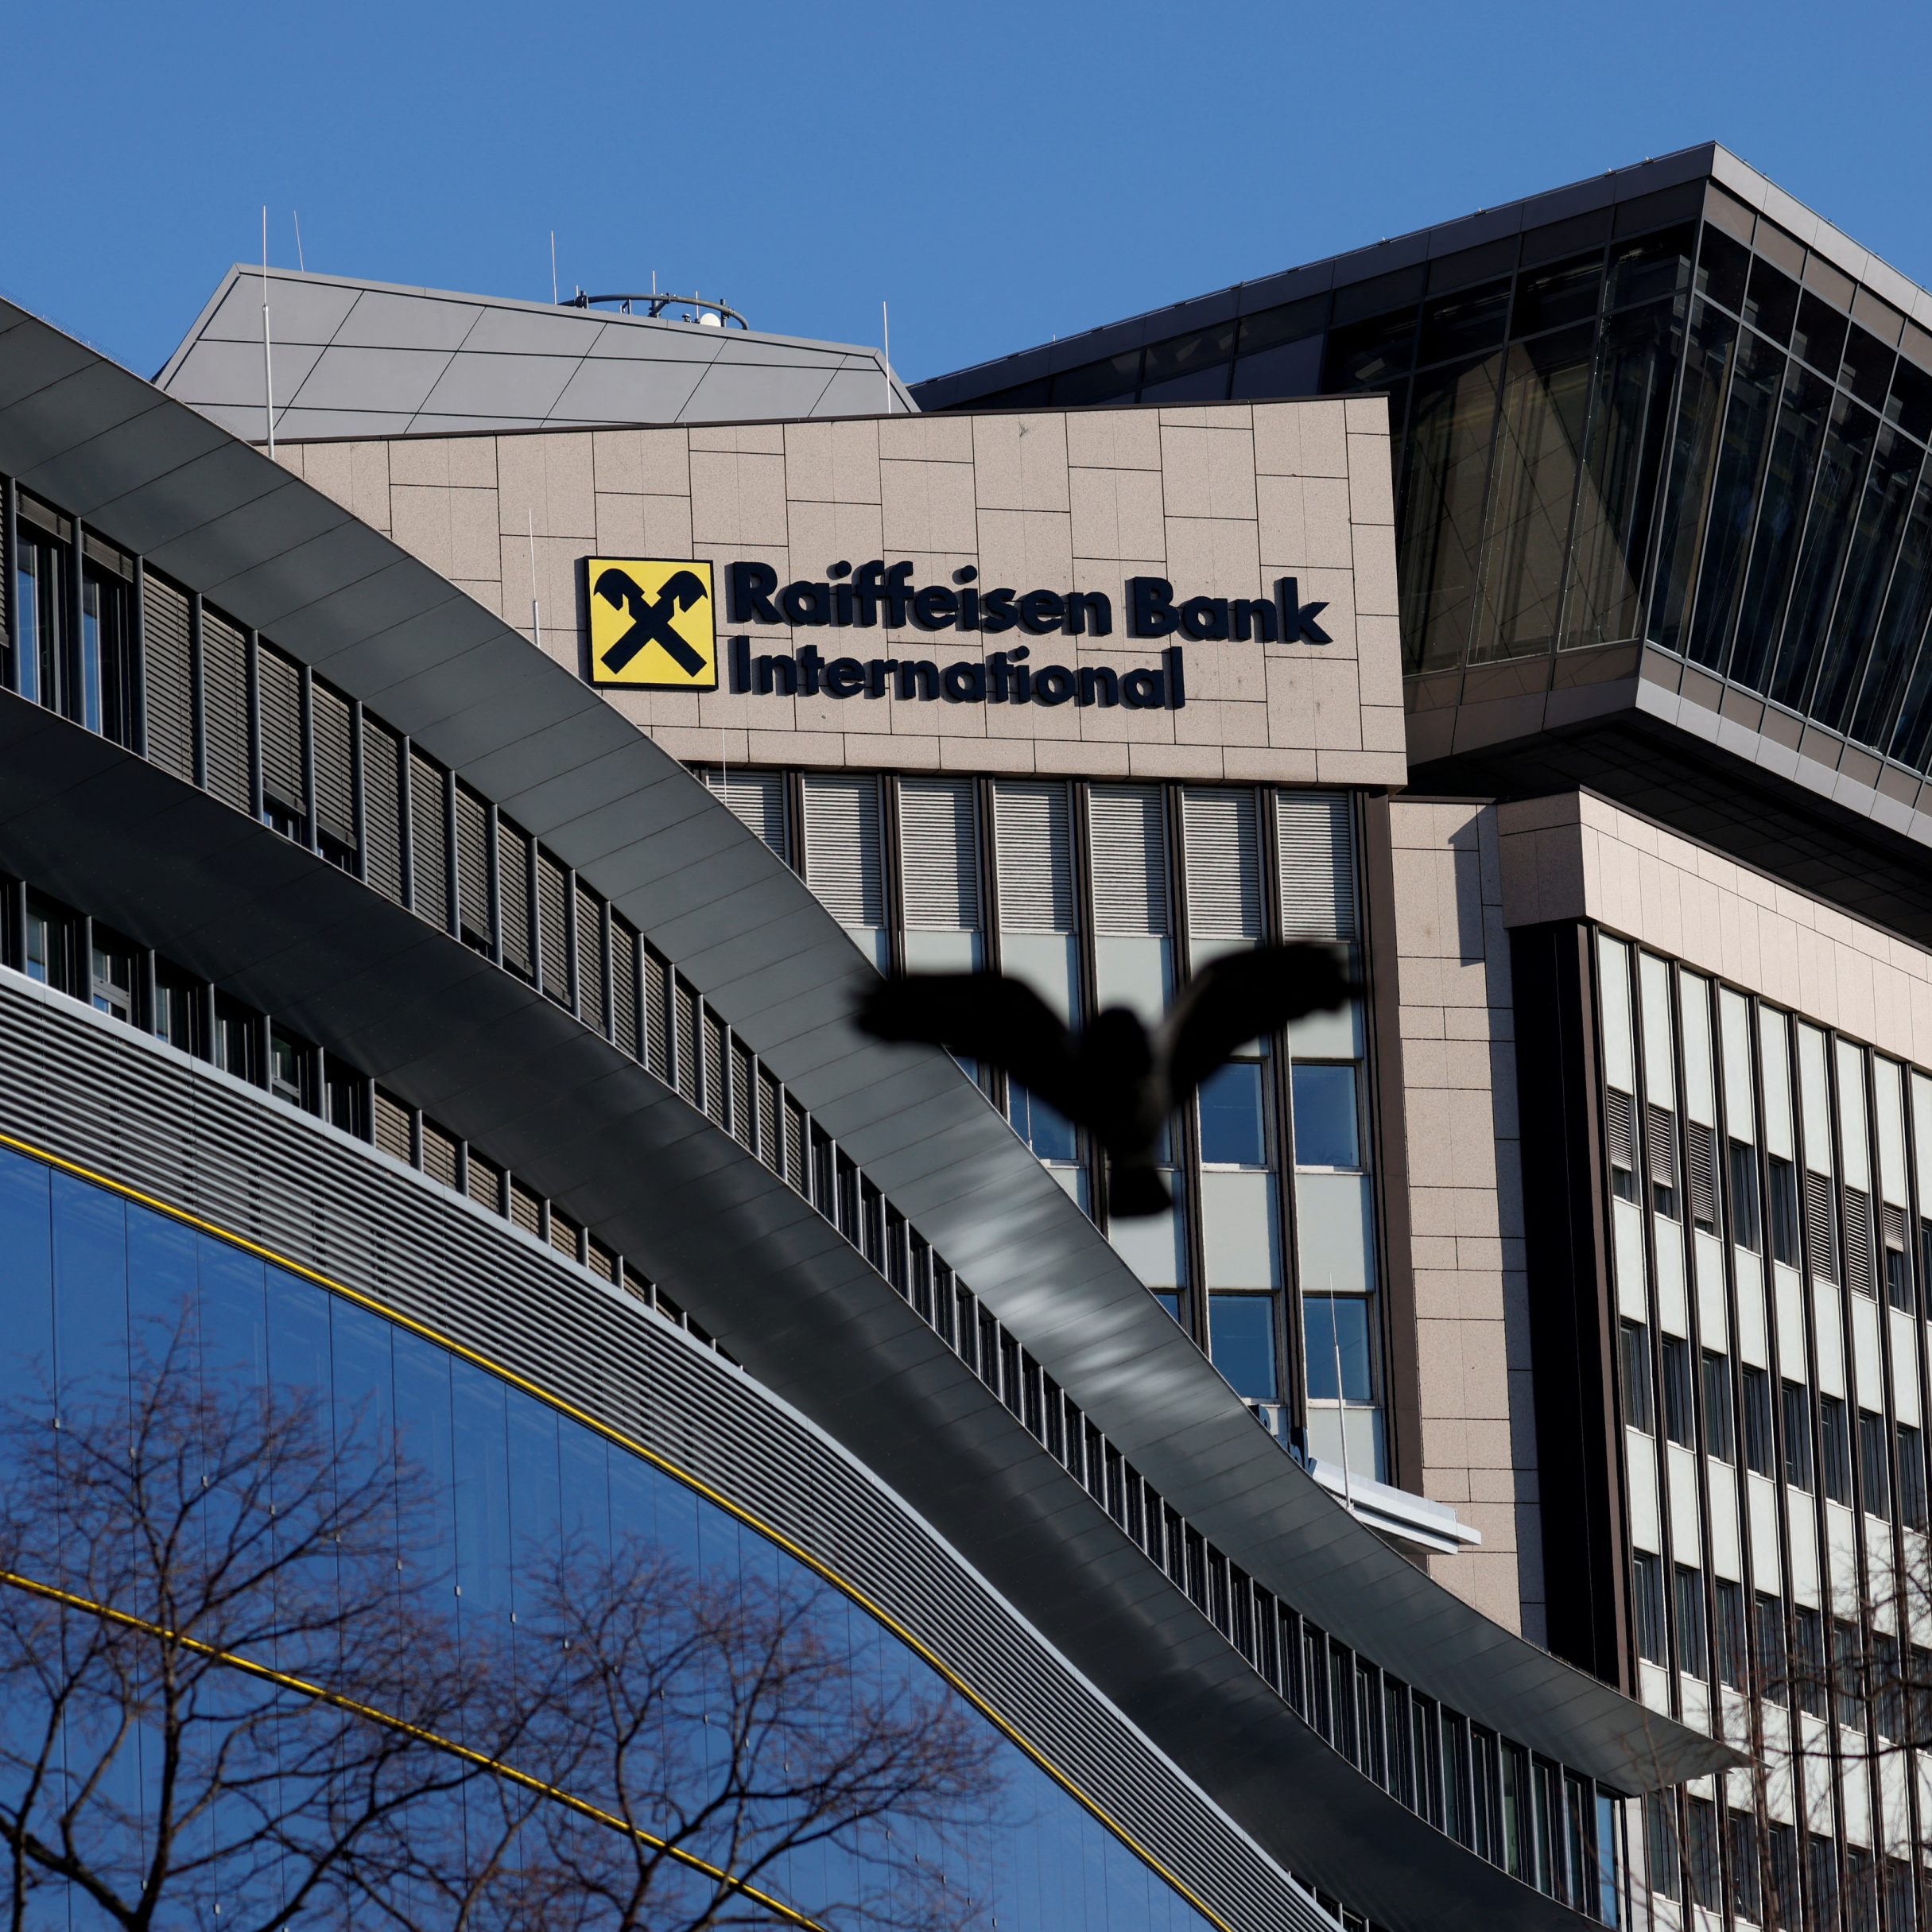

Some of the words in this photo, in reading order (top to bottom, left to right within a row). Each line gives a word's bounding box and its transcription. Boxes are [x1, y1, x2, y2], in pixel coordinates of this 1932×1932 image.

[731, 559, 1113, 637] Raiffeisen
[1129, 576, 1333, 646] Bank
[731, 636, 1187, 708] International
